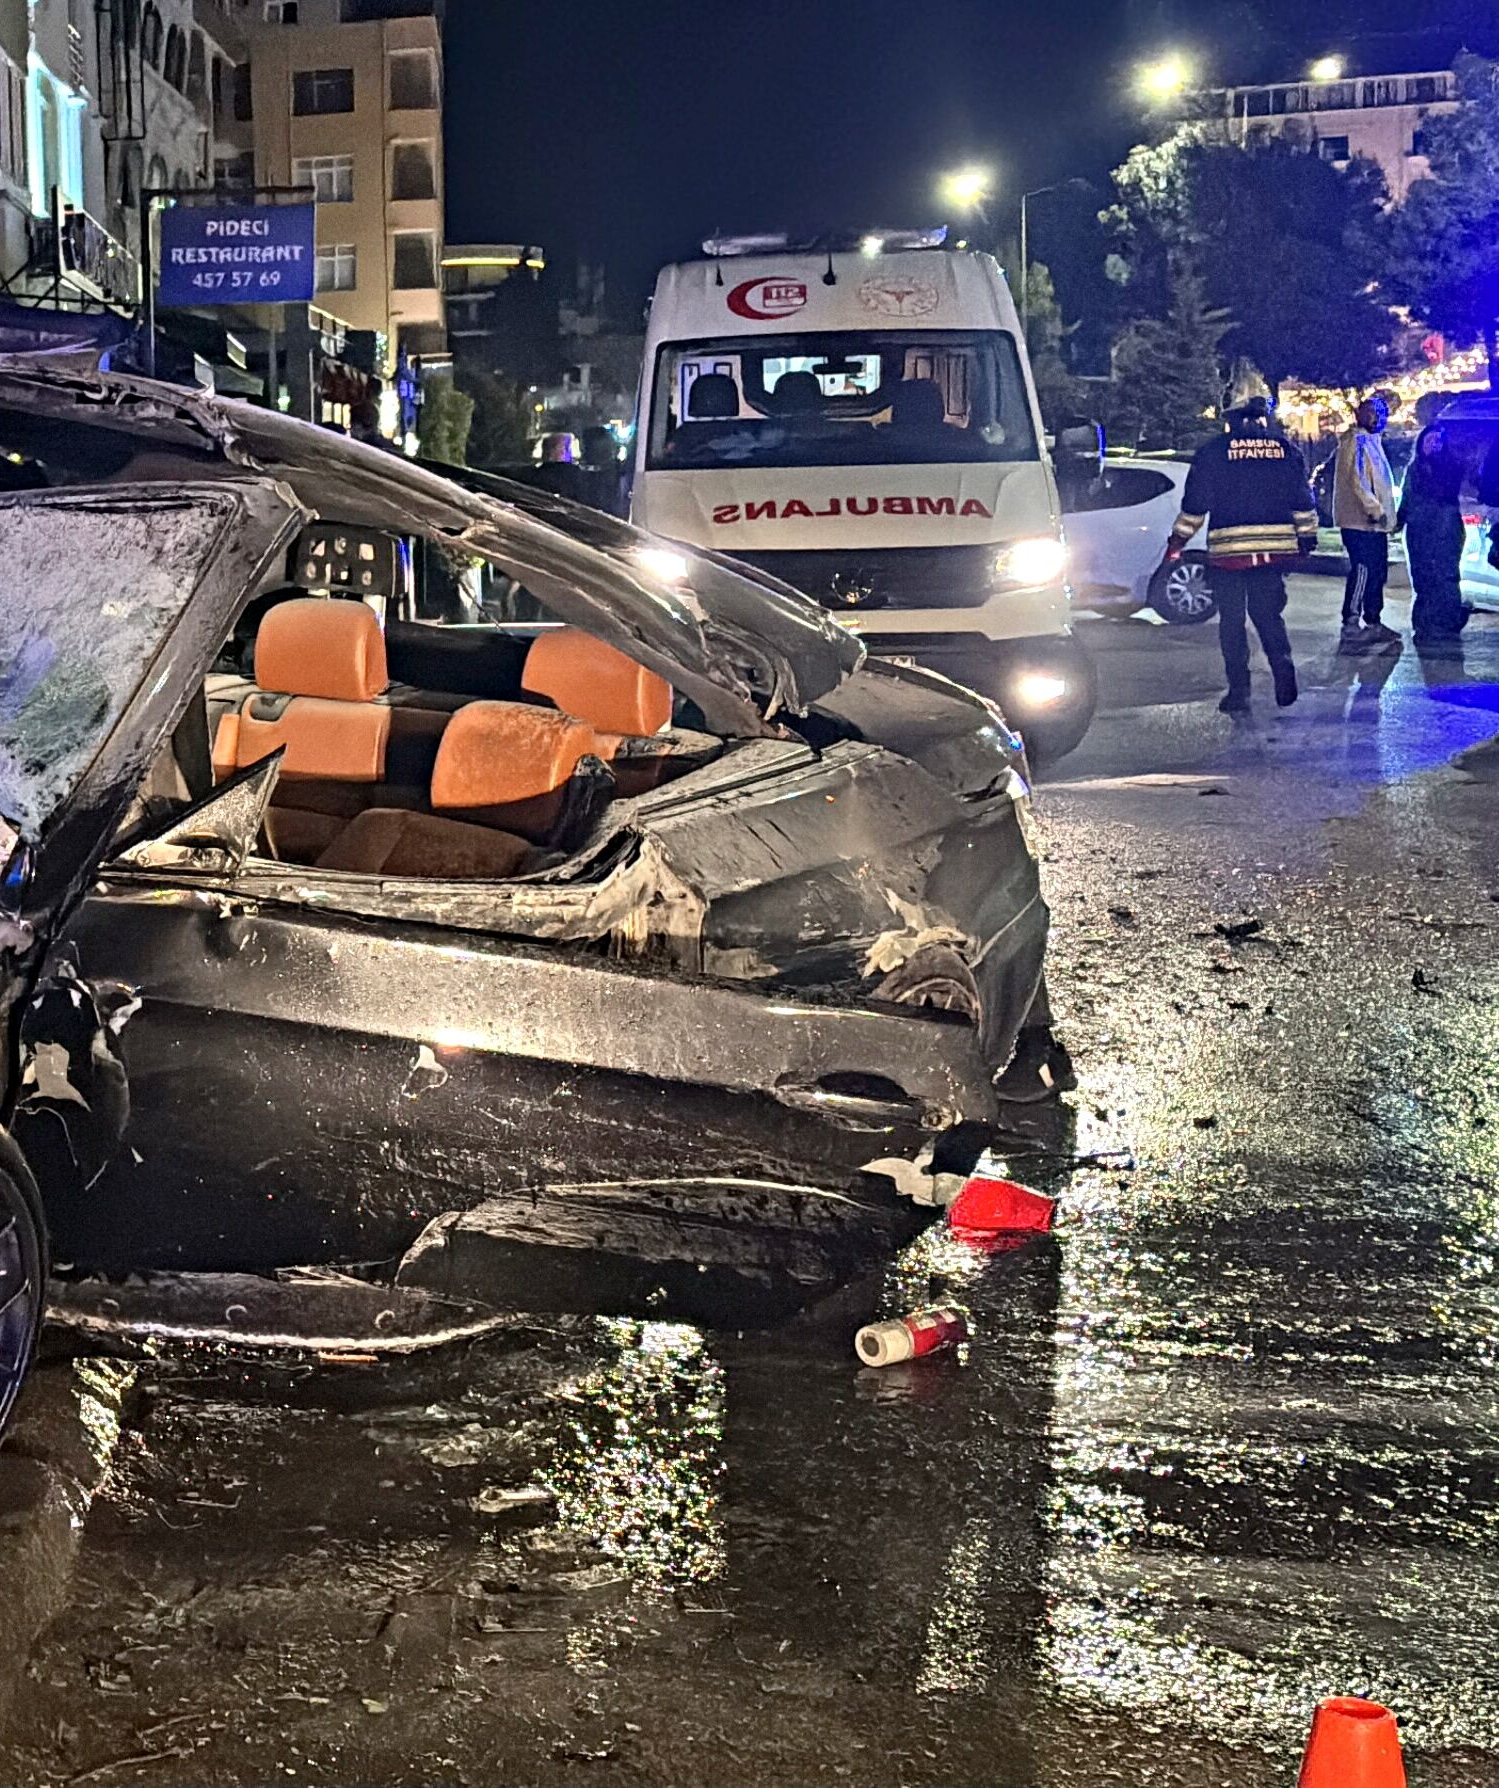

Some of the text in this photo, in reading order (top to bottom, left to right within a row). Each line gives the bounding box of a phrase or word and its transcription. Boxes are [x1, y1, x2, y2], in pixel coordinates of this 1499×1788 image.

[171, 245, 304, 264] RESTAURANT
[192, 270, 280, 287] 457 57 69
[771, 286, 801, 299] 112
[1230, 438, 1281, 449] SAMSUN
